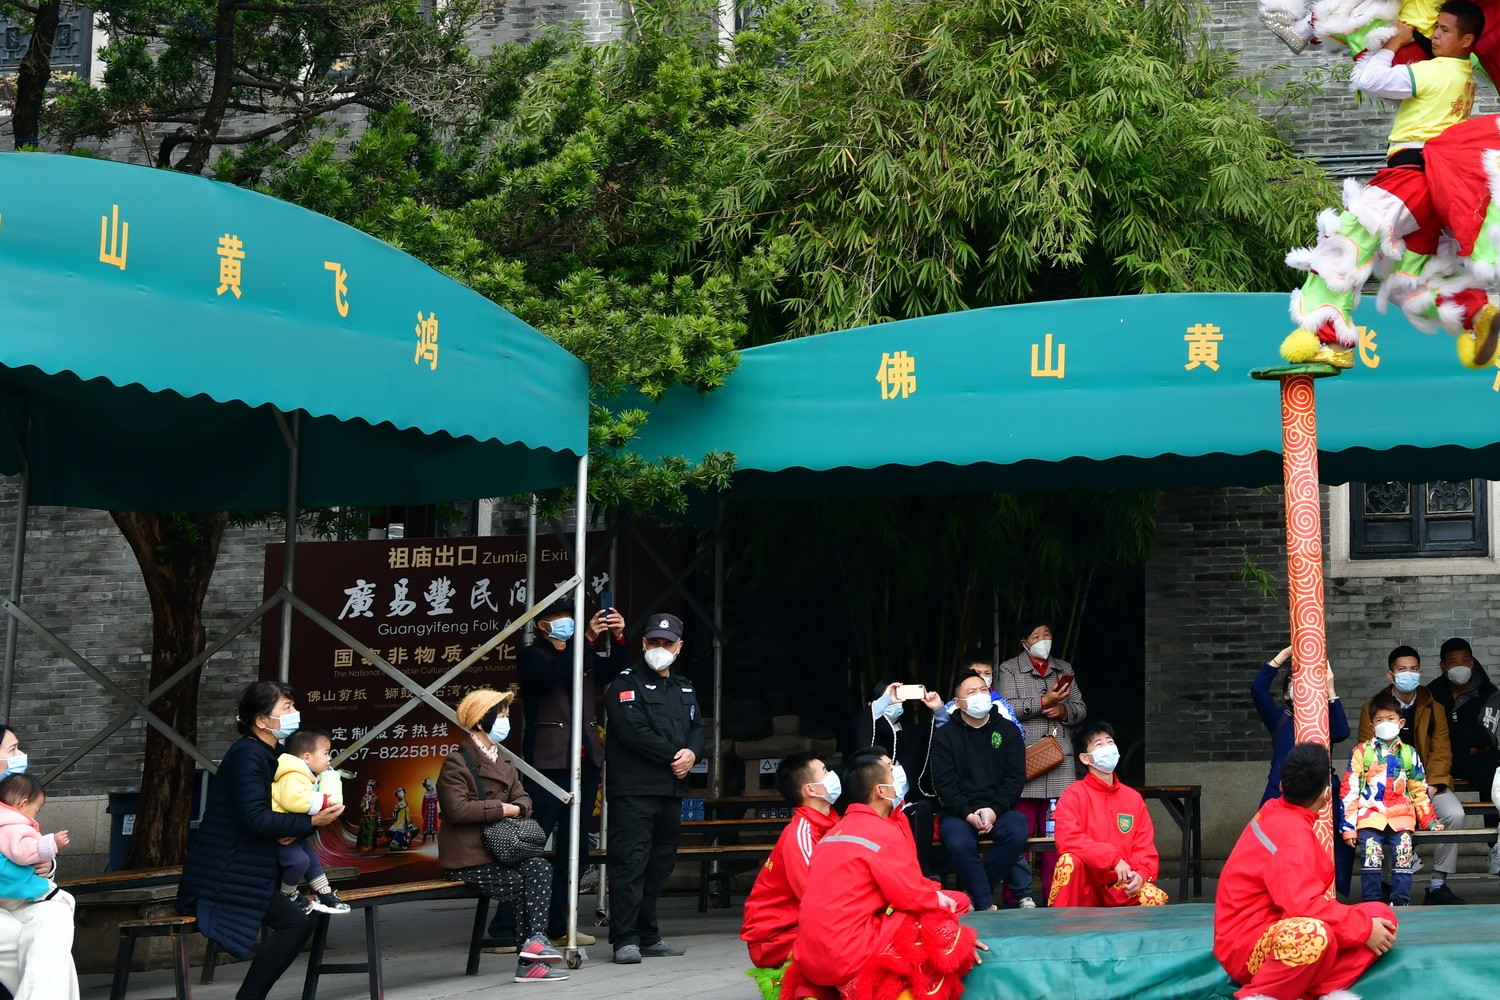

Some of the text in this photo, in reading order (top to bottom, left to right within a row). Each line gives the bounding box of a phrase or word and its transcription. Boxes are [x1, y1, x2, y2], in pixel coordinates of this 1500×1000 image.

[388, 545, 479, 569] 祖庙出口
[482, 548, 569, 565] Zumia Exit
[378, 620, 469, 637] Guangyifeng
[473, 618, 500, 632] Folk
[334, 669, 347, 678] The
[348, 668, 380, 677] National
[381, 666, 419, 677] Igible
[420, 665, 450, 675] Cultural
[485, 663, 518, 672] Museum
[307, 688, 368, 703] 佛山剪纸
